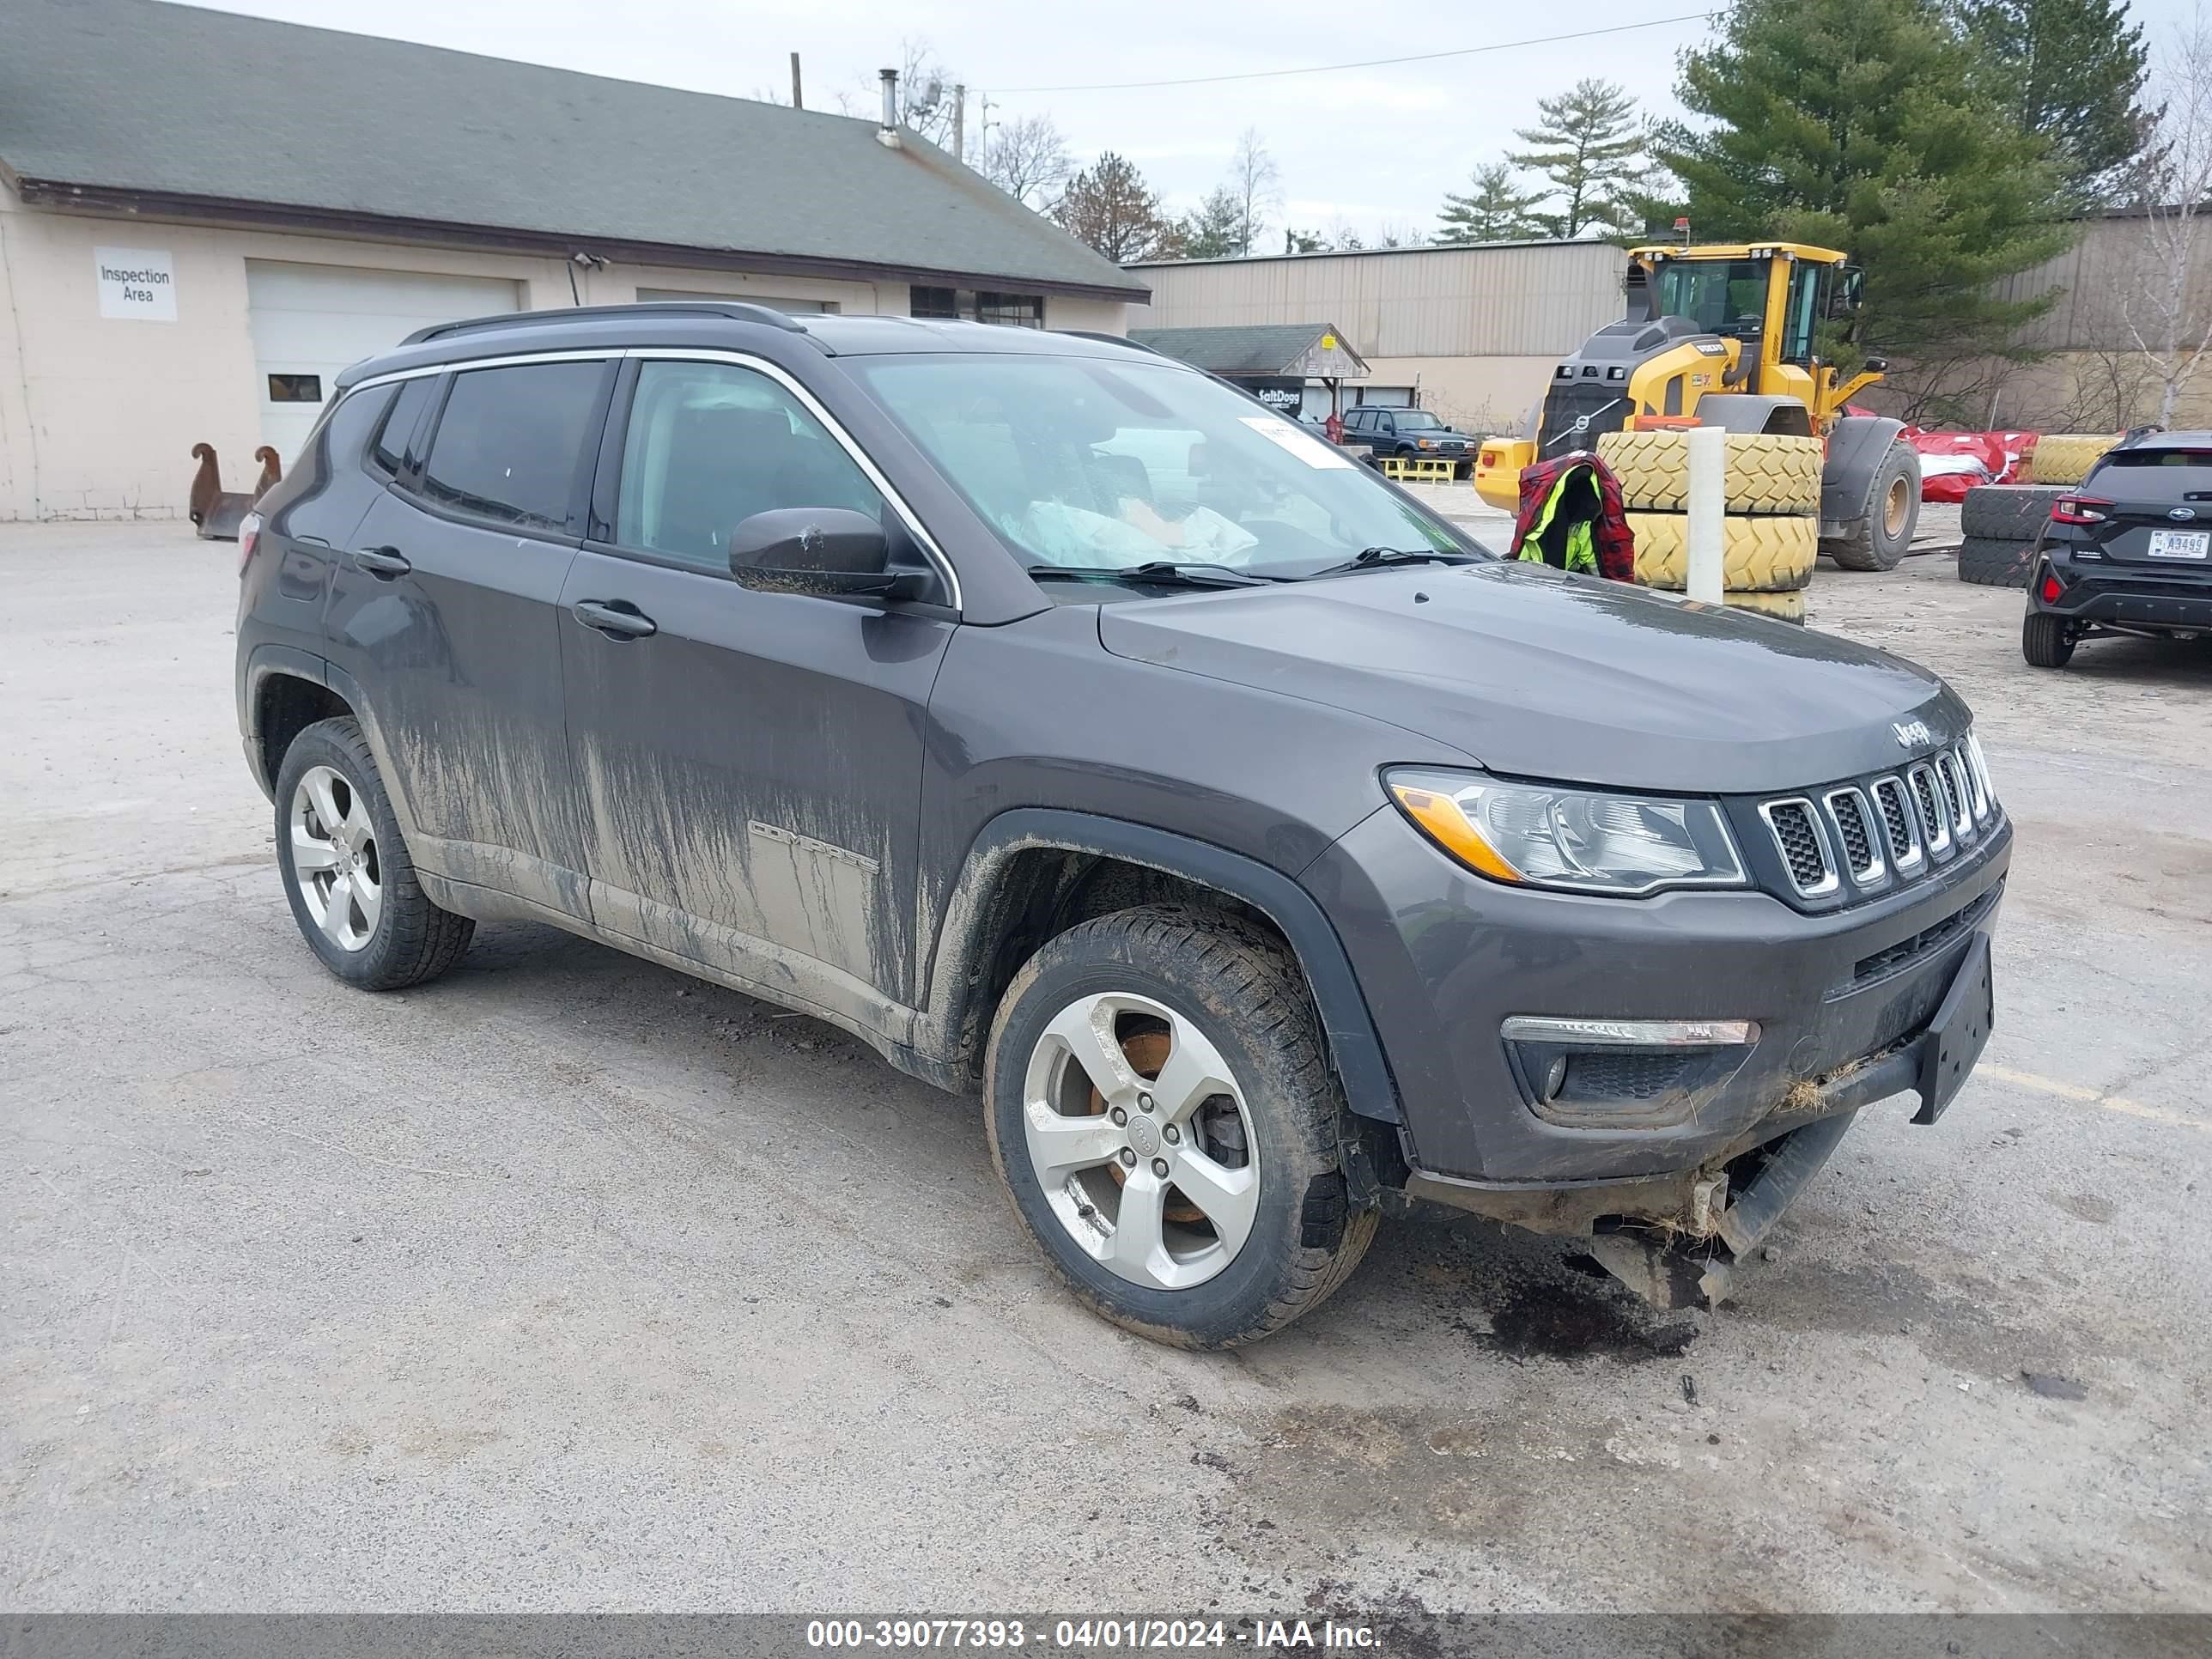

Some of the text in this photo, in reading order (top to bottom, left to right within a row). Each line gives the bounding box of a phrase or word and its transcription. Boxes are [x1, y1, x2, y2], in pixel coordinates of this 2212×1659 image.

[100, 265, 170, 284] Inspection
[124, 286, 154, 302] Area
[1258, 389, 1300, 405] SaltDogg
[2166, 537, 2203, 551] A3499
[1890, 720, 1931, 746] Jeep
[1134, 1121, 1152, 1152] Jeep
